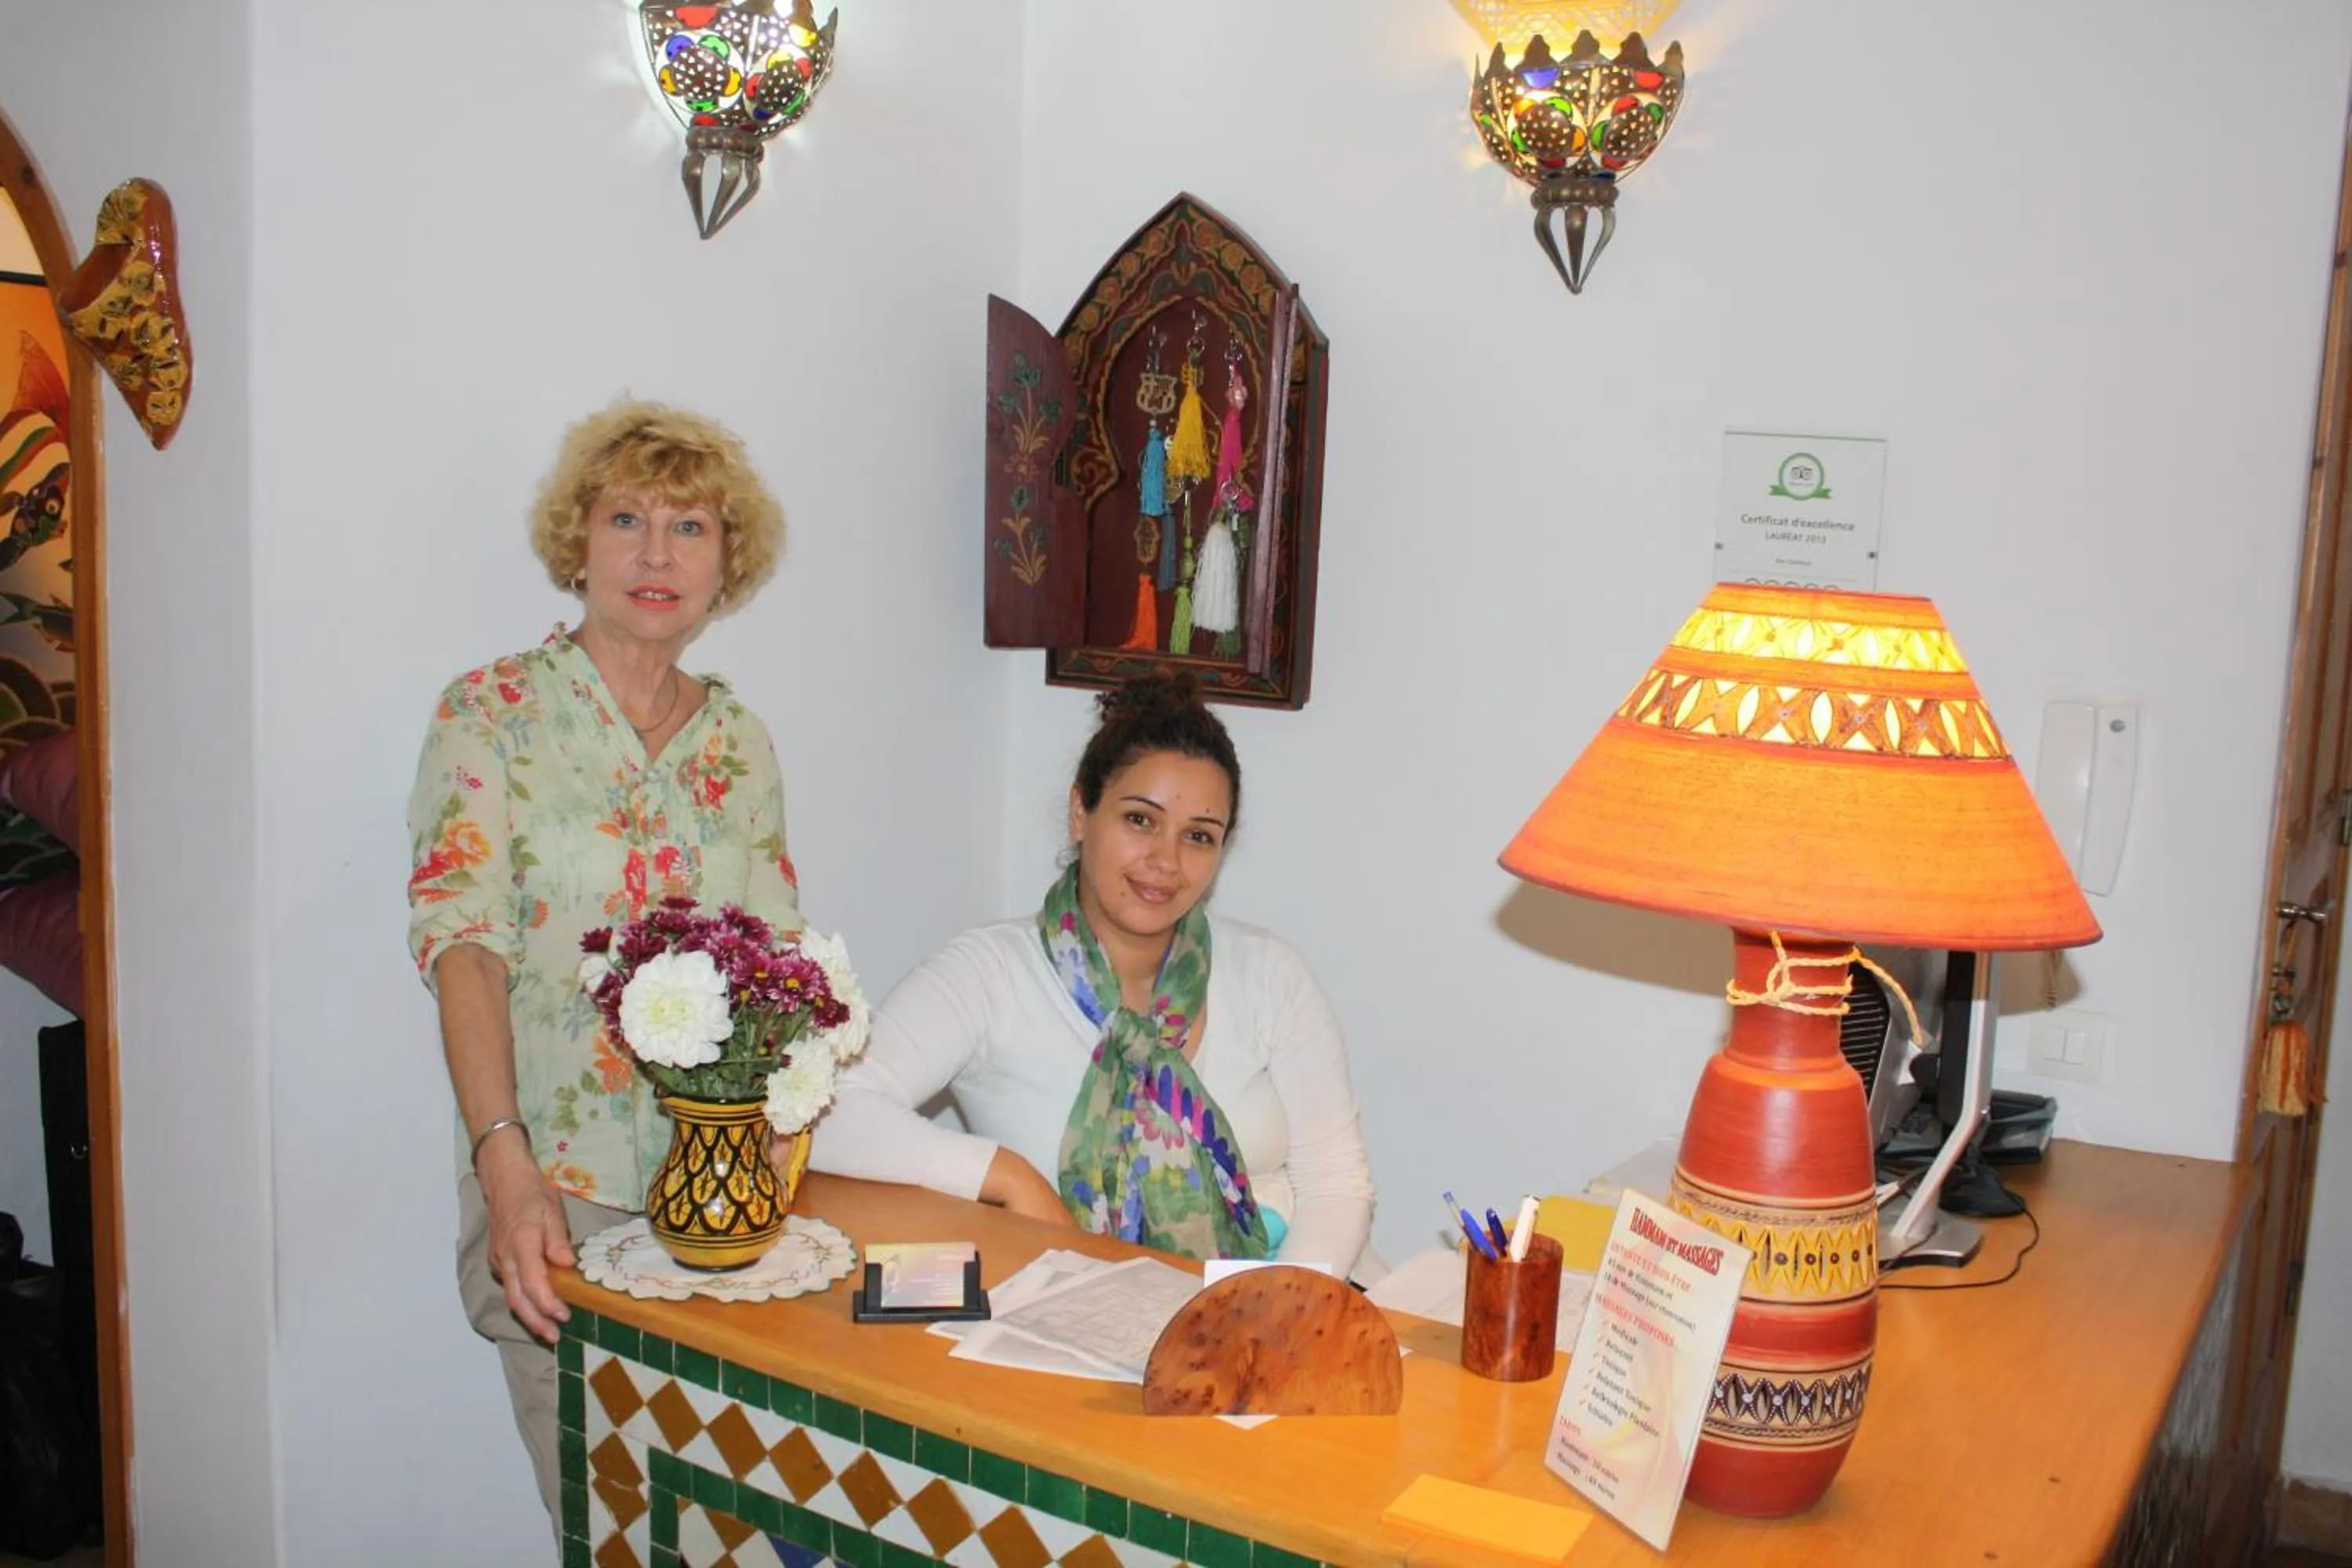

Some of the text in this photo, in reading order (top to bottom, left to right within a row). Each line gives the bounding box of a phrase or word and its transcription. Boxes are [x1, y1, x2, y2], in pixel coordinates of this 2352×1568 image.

[1741, 514, 1855, 531] Certificat d'excellence
[1629, 1207, 1724, 1276] HAMMAM ET MASSAGES
